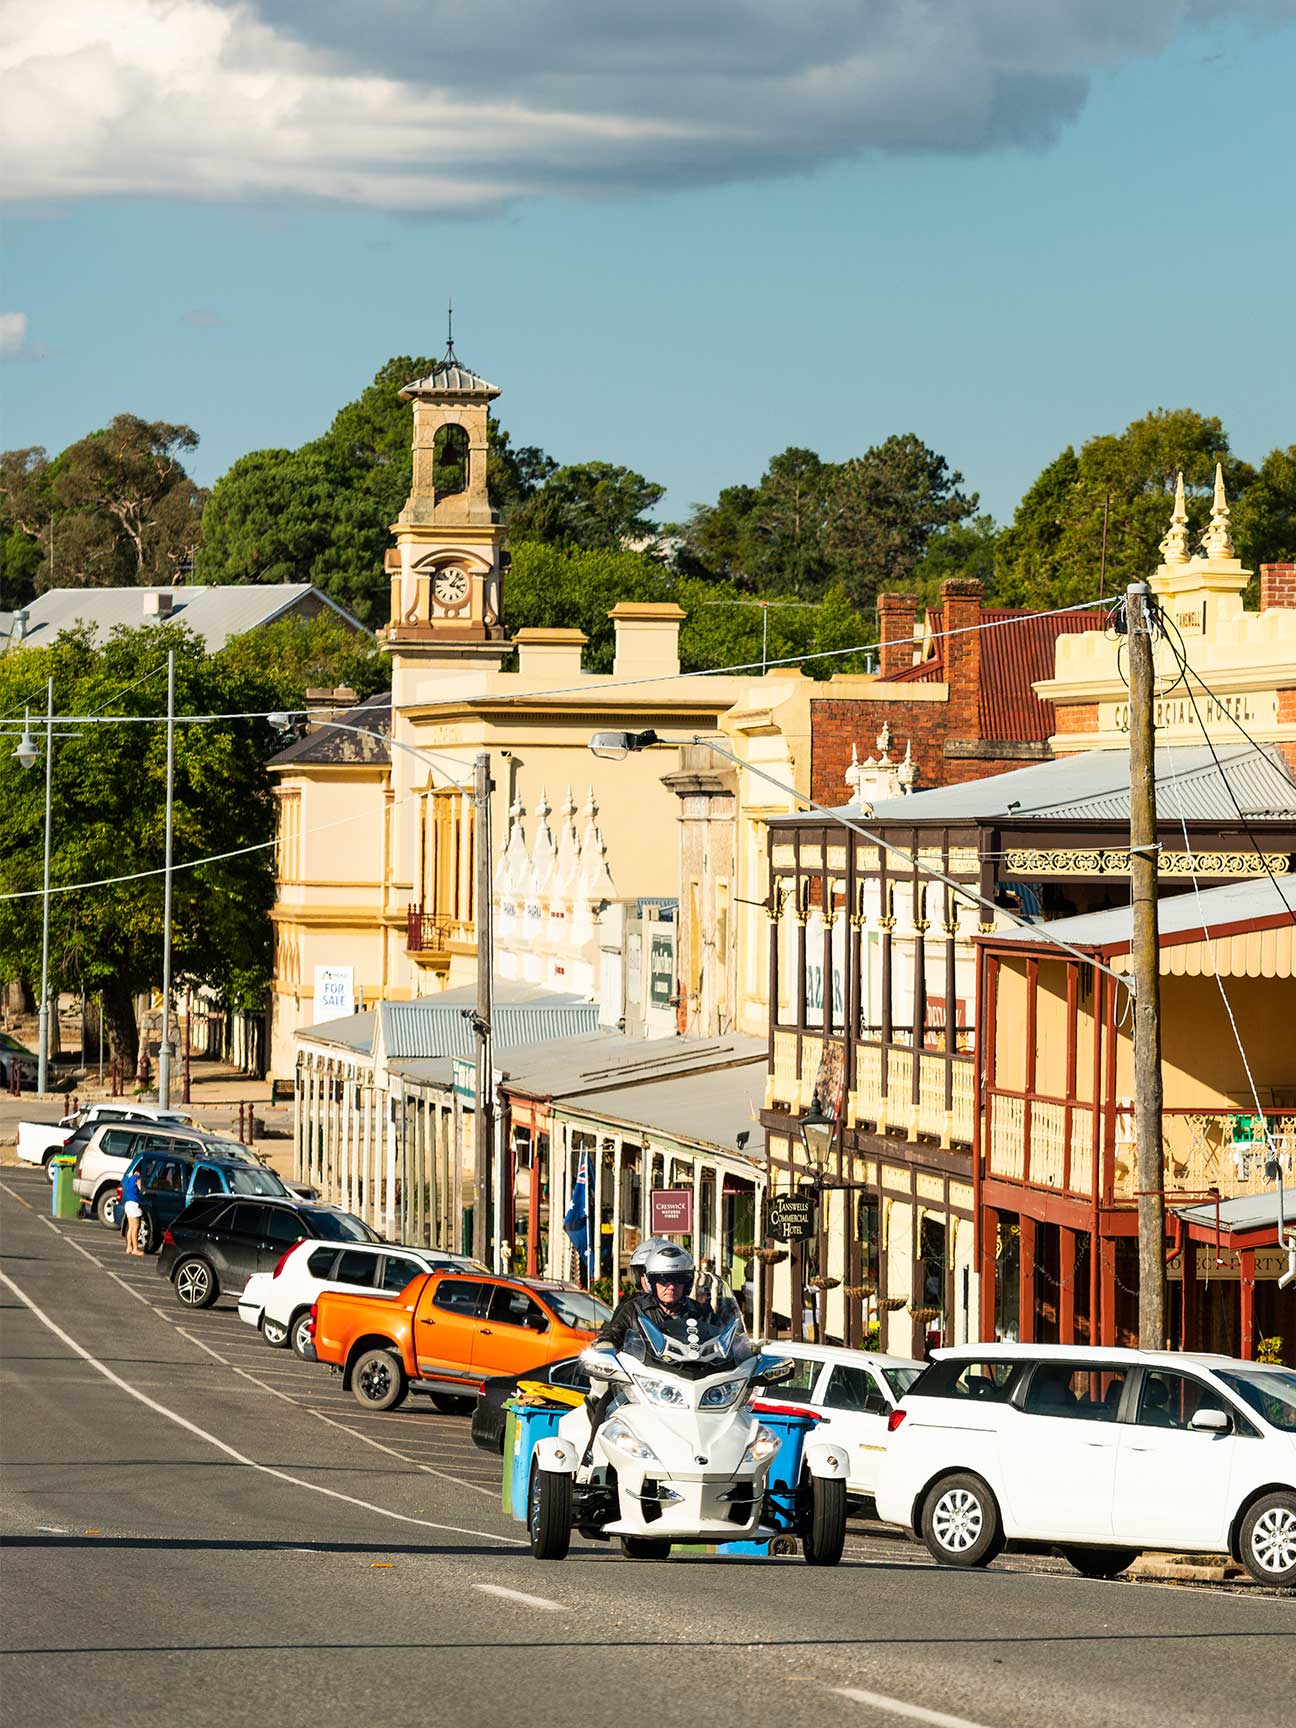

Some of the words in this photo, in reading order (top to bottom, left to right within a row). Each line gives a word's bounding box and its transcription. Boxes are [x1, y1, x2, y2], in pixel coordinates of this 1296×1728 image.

[1115, 702, 1194, 727] CORCIAL
[324, 983, 344, 994] FOR
[322, 995, 345, 1006] SALE
[777, 1199, 809, 1213] TANSWELLS
[771, 1210, 809, 1225] COMMERCIAL
[783, 1222, 803, 1236] HOTEL
